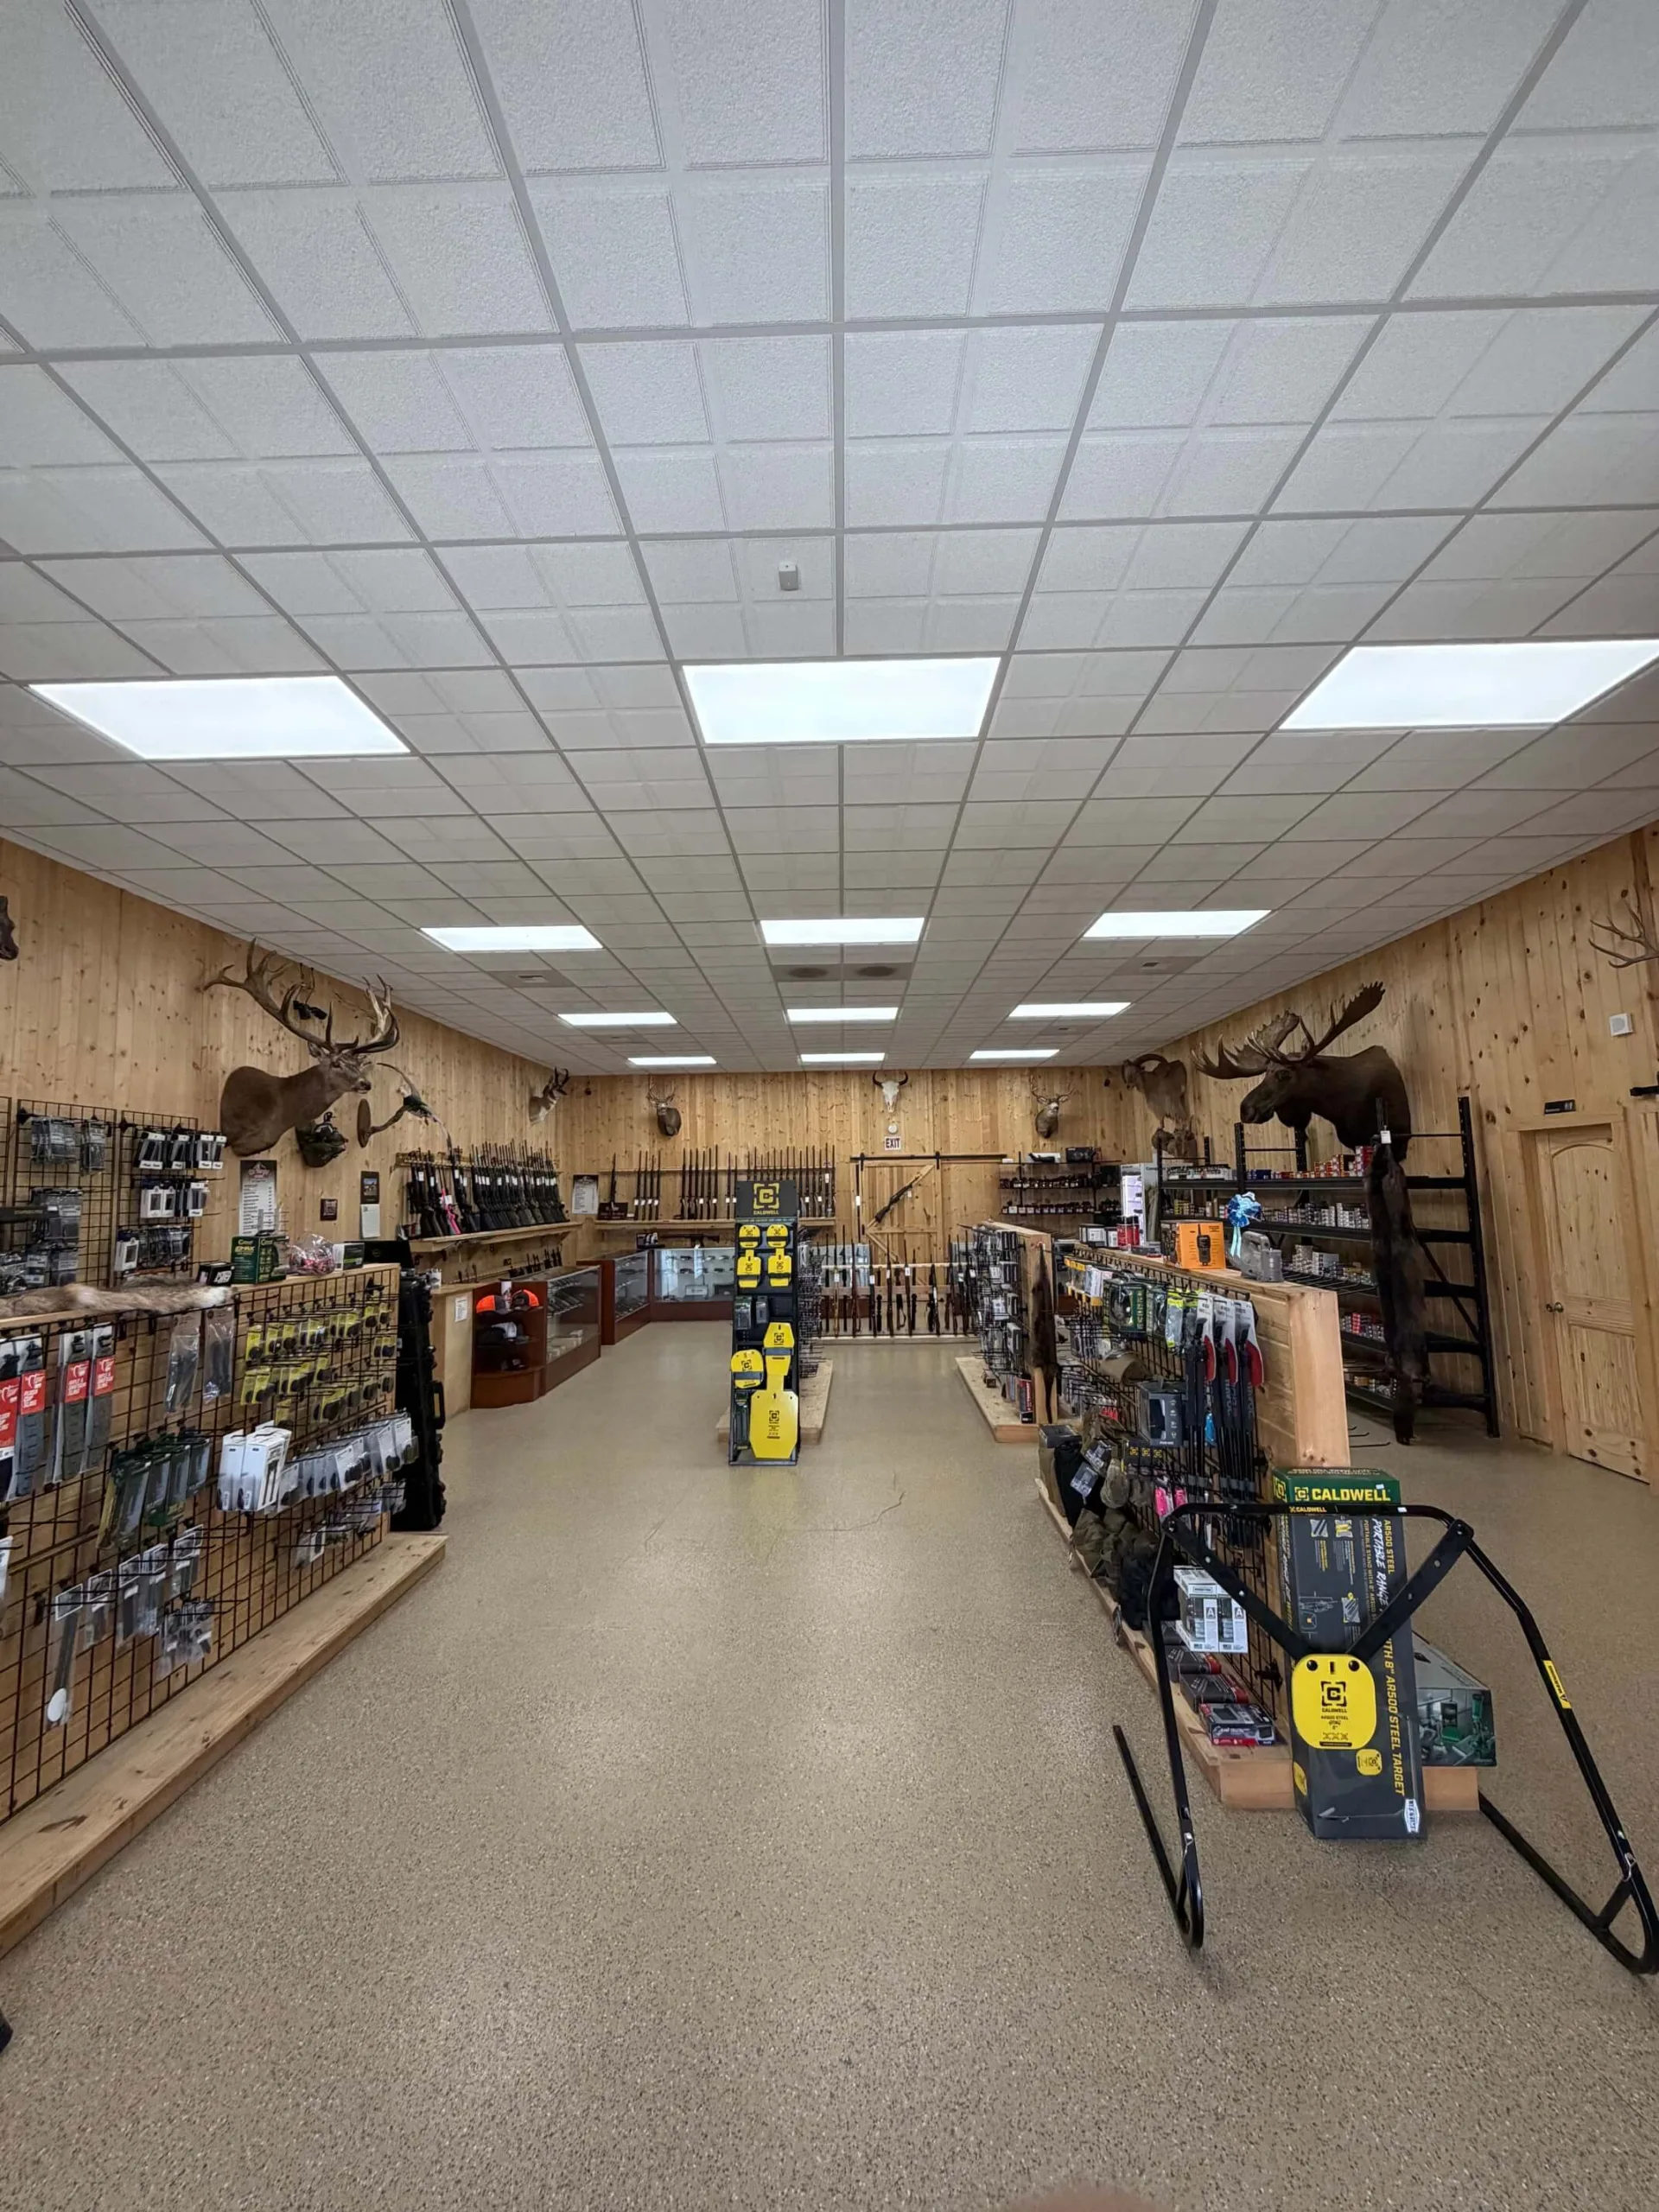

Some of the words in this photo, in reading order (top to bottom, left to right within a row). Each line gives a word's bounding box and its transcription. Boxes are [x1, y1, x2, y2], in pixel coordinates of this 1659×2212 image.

[886, 1137, 900, 1148] EXIT
[1312, 1488, 1391, 1502] CALDWELL
[1371, 1518, 1386, 1569] PORTABLE
[1383, 1519, 1393, 1548] AR500
[1386, 1548, 1395, 1574] STEEL
[1376, 1571, 1389, 1606] RANGE
[1384, 1661, 1395, 1674] 8"
[1386, 1675, 1399, 1715] AR500
[1389, 1716, 1401, 1750] STEEL
[1392, 1751, 1405, 1796] TARGET
